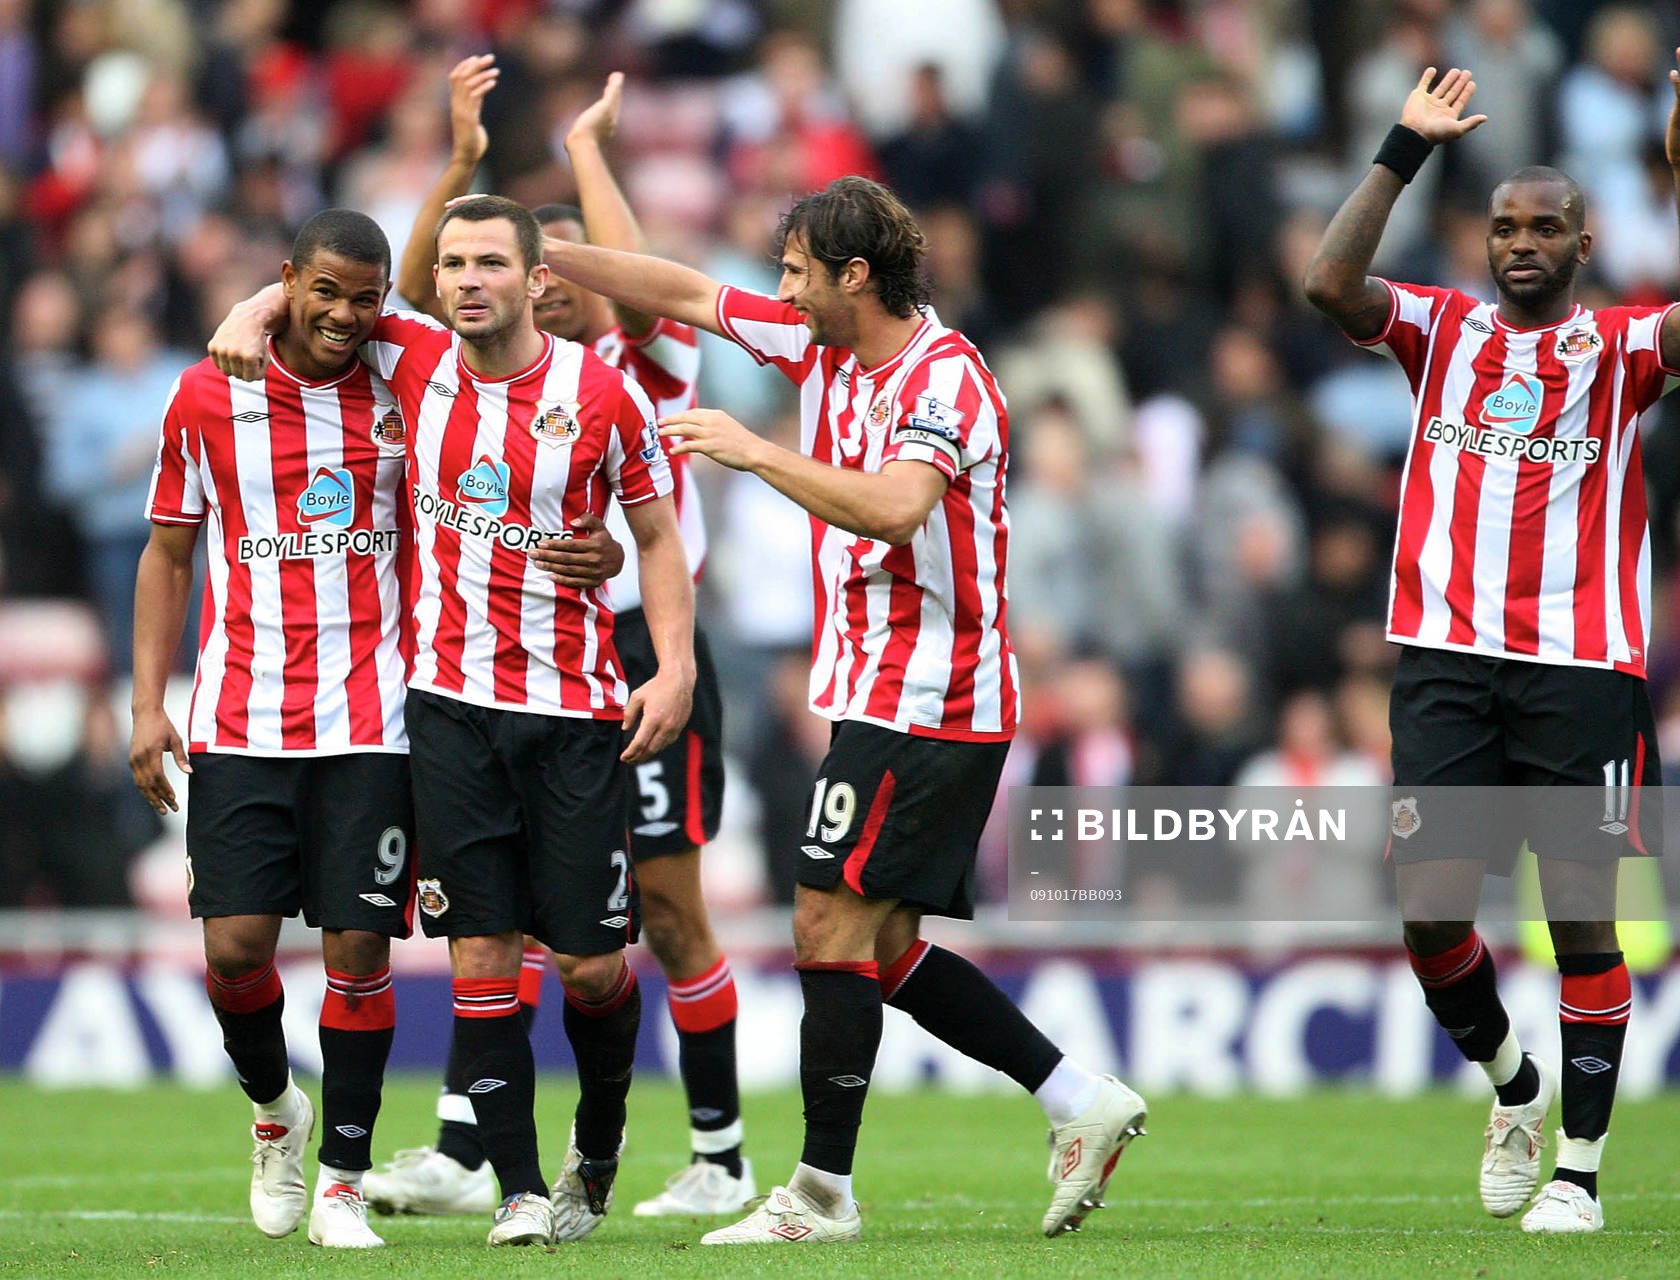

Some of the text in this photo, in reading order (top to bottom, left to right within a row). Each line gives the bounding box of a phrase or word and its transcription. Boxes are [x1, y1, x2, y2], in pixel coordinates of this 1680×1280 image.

[1493, 395, 1537, 415] Boyle
[1426, 419, 1599, 461] BOYLESPORTS
[306, 491, 350, 509] Boyle
[465, 474, 505, 496] Boyle
[241, 530, 400, 560] BOYLESPORT
[636, 761, 670, 822] 5
[806, 777, 857, 843] 19
[1603, 759, 1628, 821] 11
[374, 825, 407, 885] 9
[607, 849, 628, 912] 2
